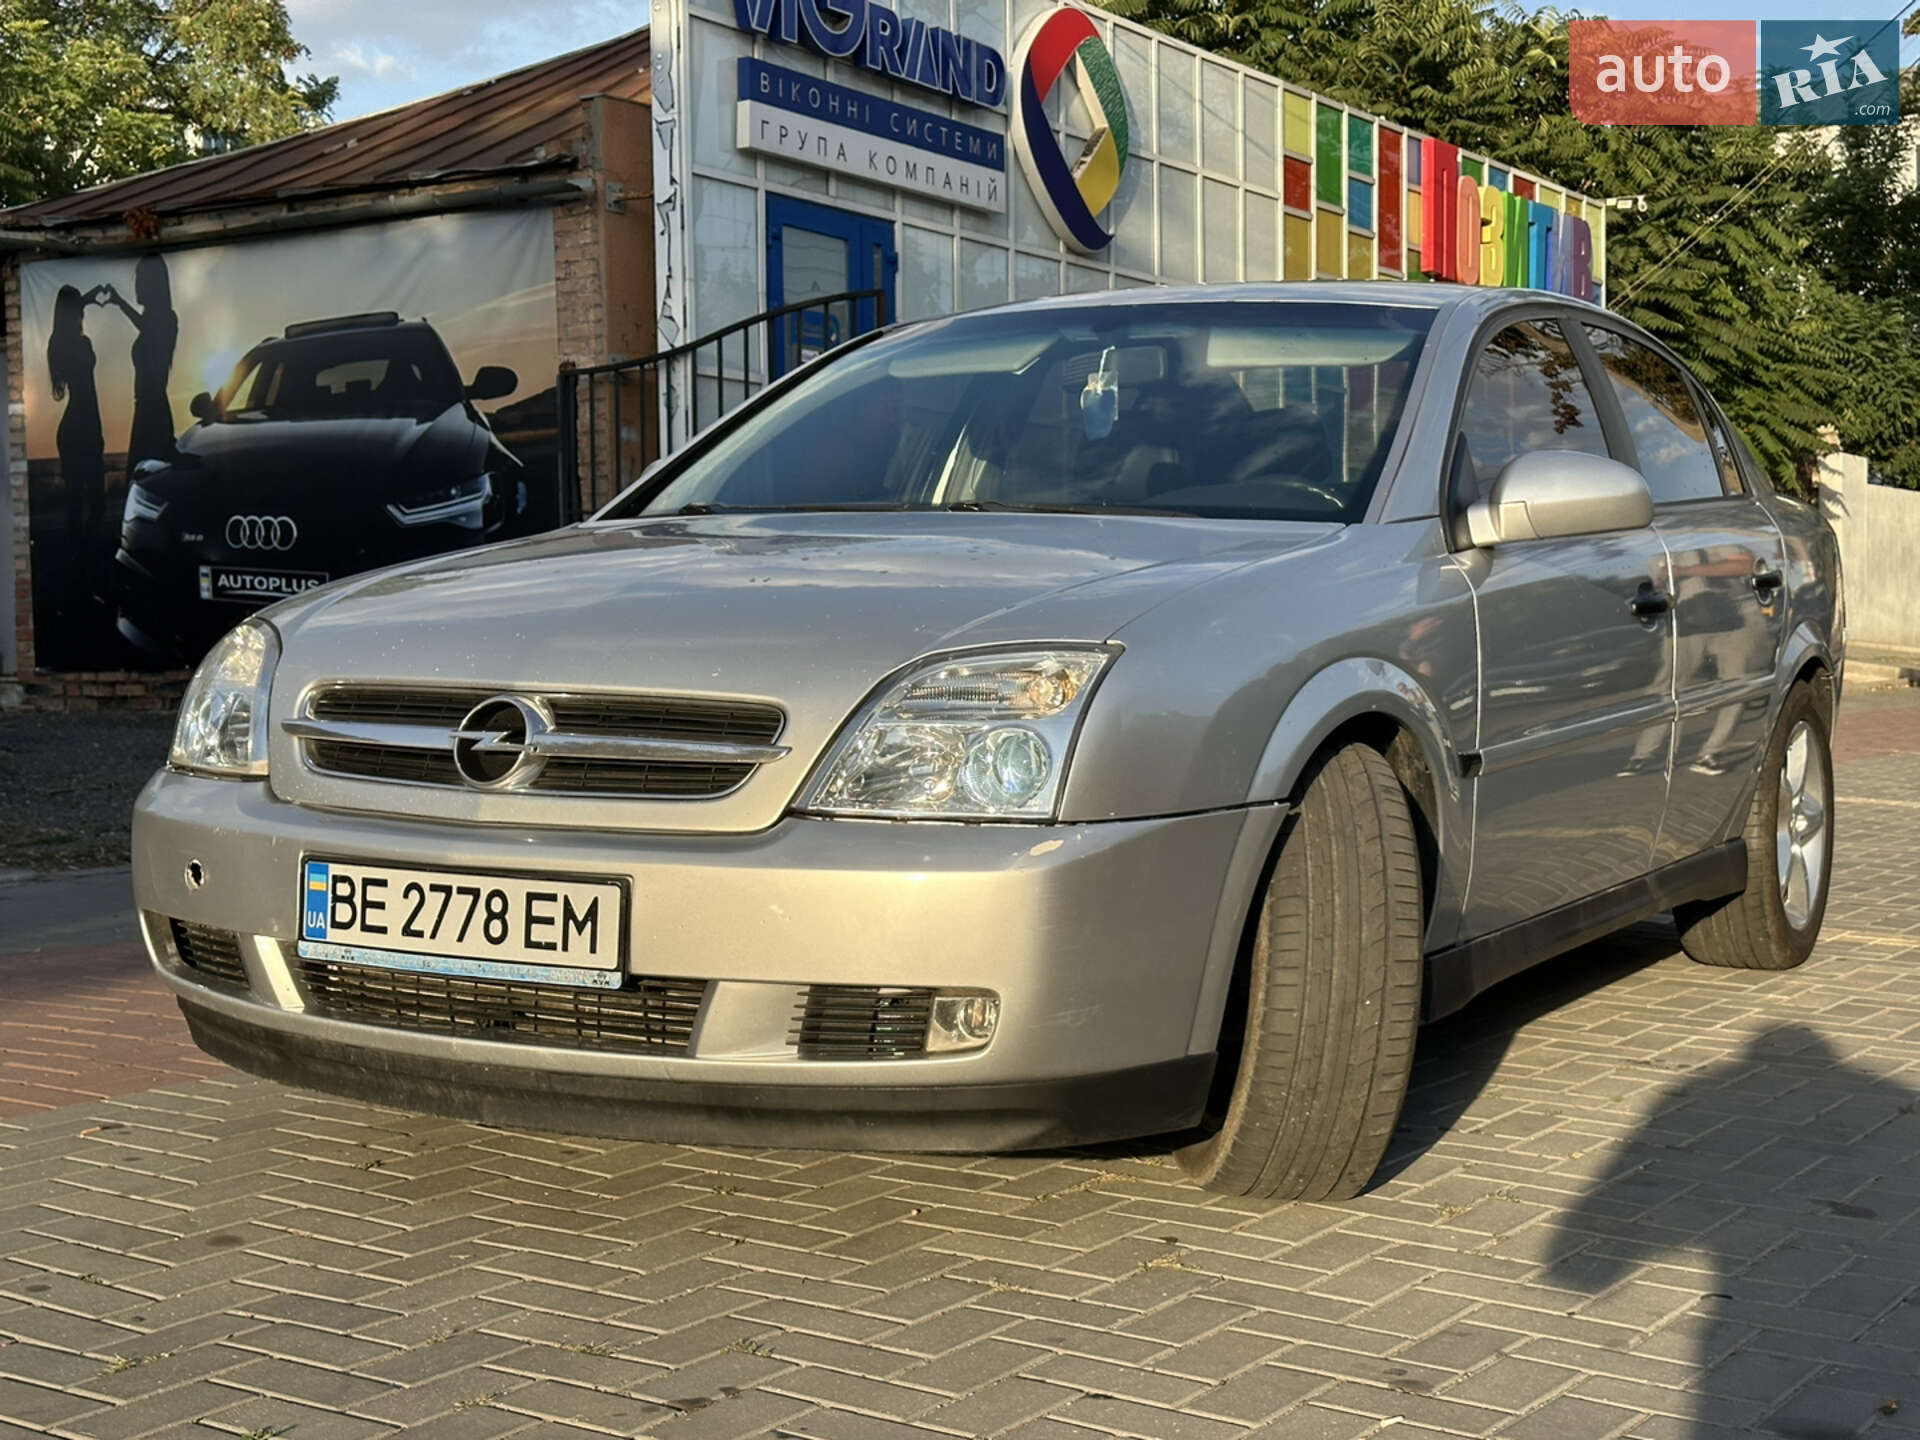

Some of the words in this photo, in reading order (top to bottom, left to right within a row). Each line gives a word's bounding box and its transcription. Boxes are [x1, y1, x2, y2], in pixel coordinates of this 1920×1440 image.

[760, 71, 870, 124] ВІКОННІ
[890, 112, 998, 161] СИСТЕМИ
[760, 119, 847, 162] ГРУПА
[868, 150, 998, 202] КОМПАНІЙ
[1420, 136, 1593, 301] ПОЗИТИВ
[217, 573, 320, 592] AUTOPLUS
[307, 911, 326, 930] UA
[330, 874, 389, 935] BE
[401, 881, 509, 945] 2778
[524, 892, 599, 955] EM
